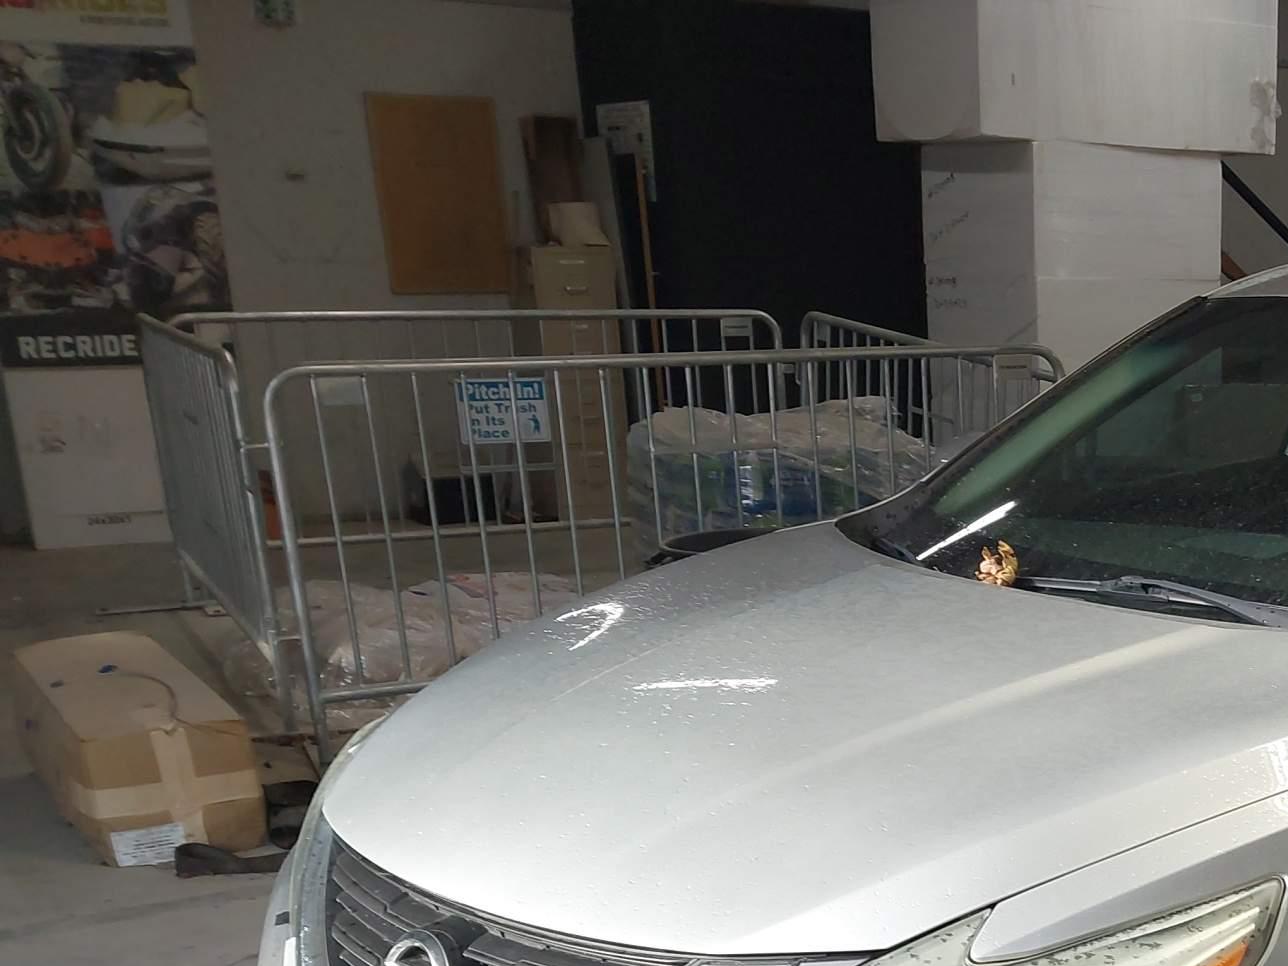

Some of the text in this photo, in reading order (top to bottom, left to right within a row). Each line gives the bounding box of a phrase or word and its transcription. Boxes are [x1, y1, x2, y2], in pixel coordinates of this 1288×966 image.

[516, 382, 540, 399] In!
[495, 402, 537, 414] Trsh
[486, 415, 505, 426] Its
